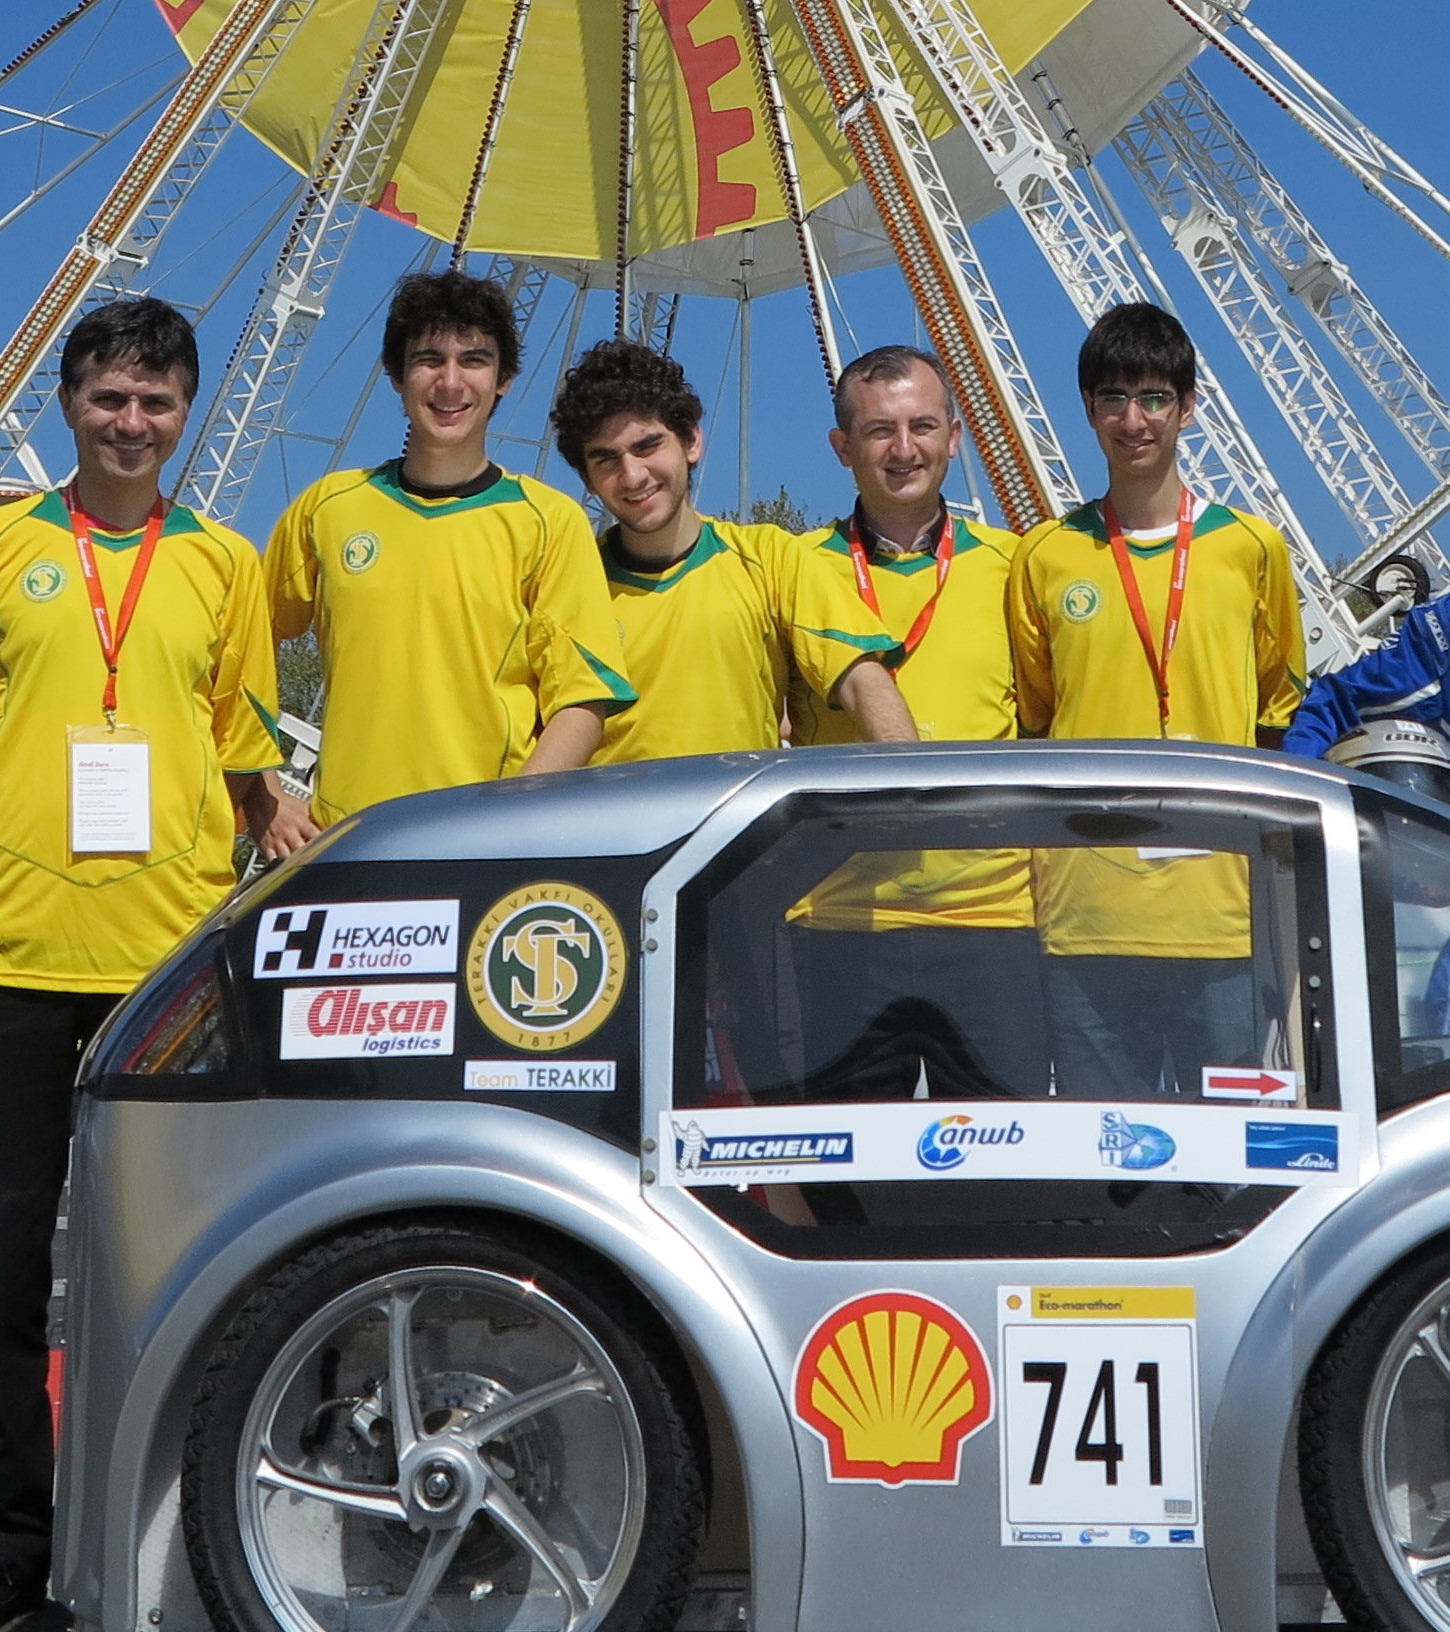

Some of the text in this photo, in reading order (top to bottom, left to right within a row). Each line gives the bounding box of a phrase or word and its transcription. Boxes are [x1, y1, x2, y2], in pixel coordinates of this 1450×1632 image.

[332, 924, 450, 949] HEXAGON
[348, 949, 412, 968] studio
[362, 1035, 441, 1054] logistics
[517, 1031, 571, 1047] 1877
[470, 1072, 518, 1087] Team
[939, 1120, 1024, 1145] anwb
[709, 1138, 848, 1160] MICHELIN
[1286, 1152, 1335, 1169] Linde
[1023, 1359, 1162, 1486] 741
